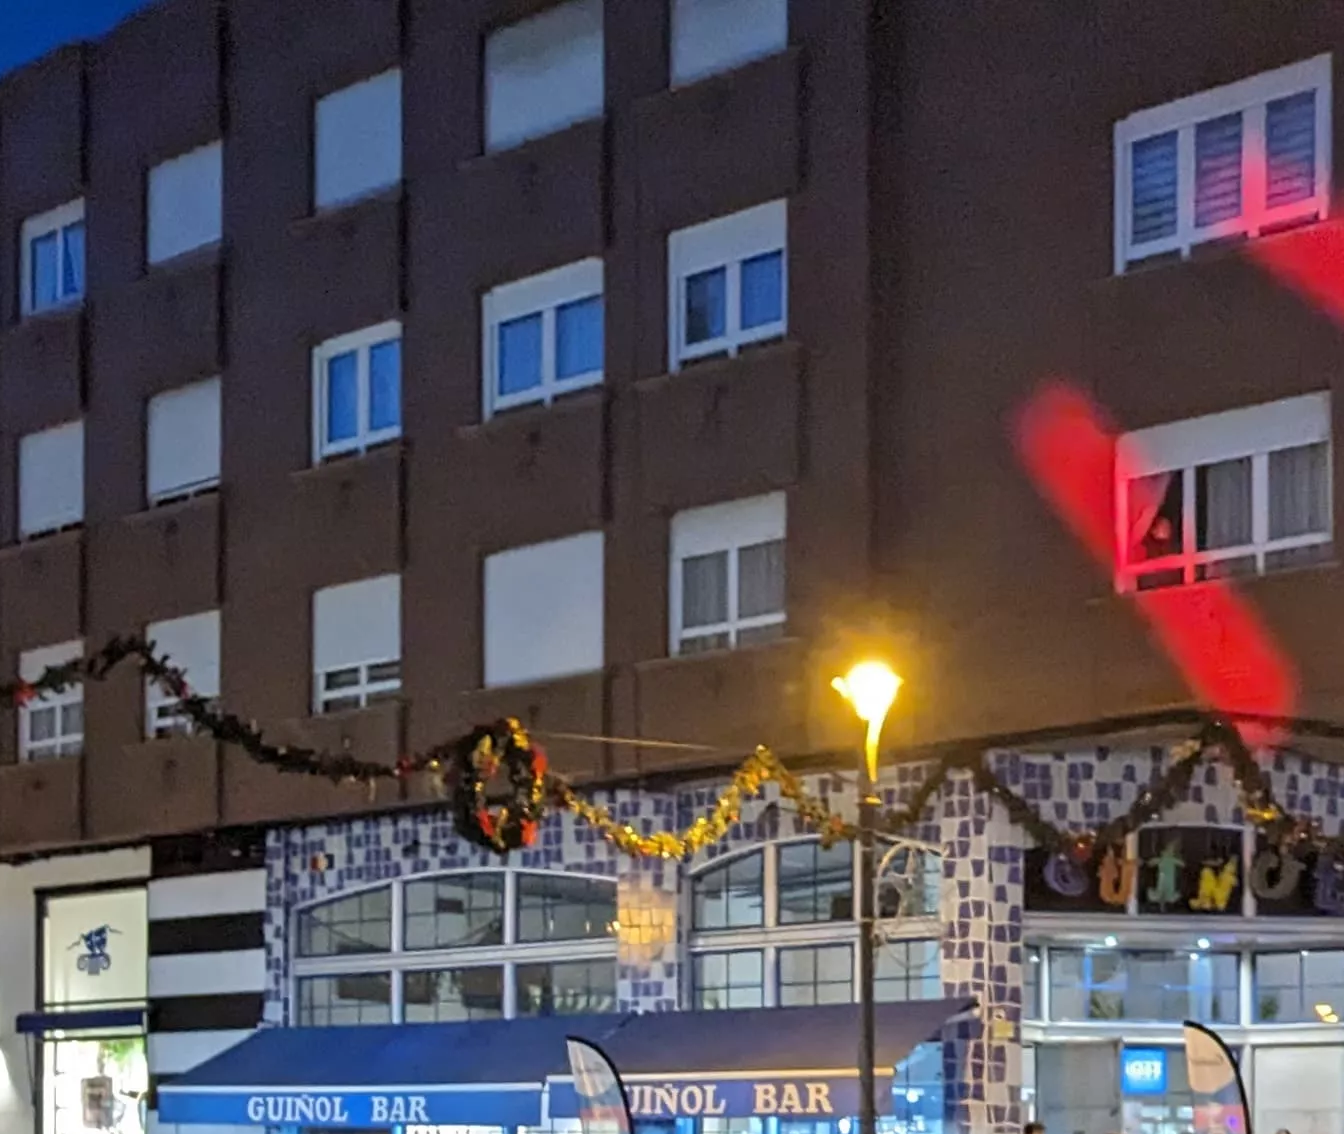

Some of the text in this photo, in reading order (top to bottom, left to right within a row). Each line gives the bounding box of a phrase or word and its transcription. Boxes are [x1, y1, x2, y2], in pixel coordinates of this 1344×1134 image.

[247, 1094, 429, 1122] GUIÑOL BAR
[623, 1083, 833, 1114] UIÑOL BAR
